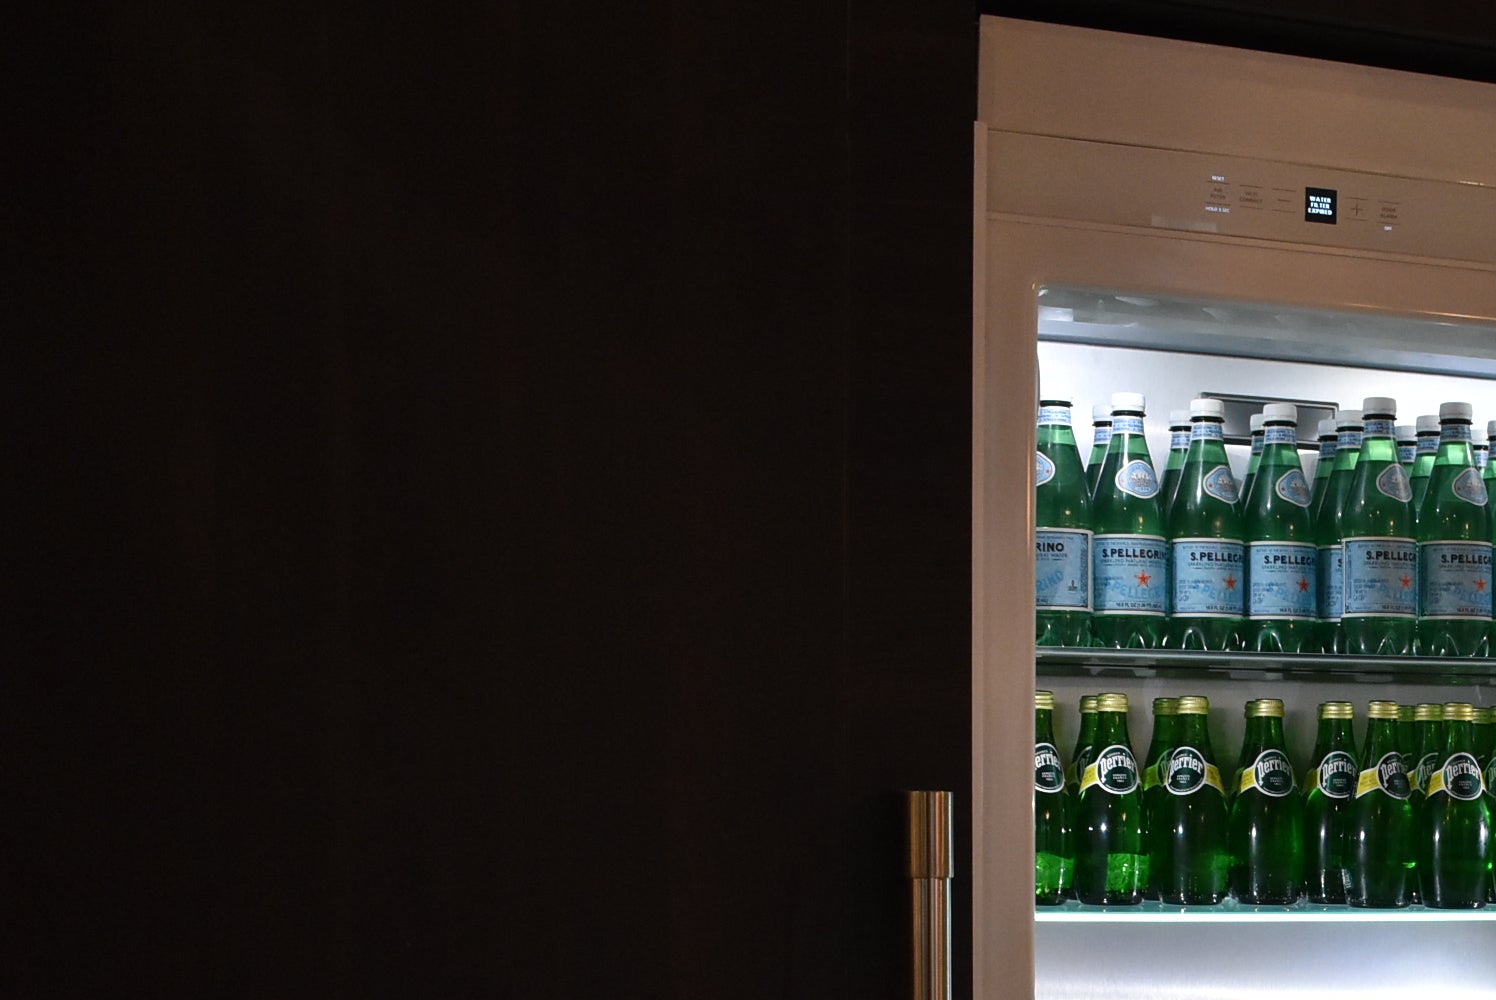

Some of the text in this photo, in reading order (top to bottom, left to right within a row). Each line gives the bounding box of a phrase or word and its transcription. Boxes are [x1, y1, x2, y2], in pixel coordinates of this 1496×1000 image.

[1308, 207, 1333, 215] EXPIRED
[1100, 753, 1136, 783] Perrier
[1168, 754, 1203, 784] Perrier
[1257, 756, 1291, 786] Perrier
[1446, 760, 1479, 789] Perrier
